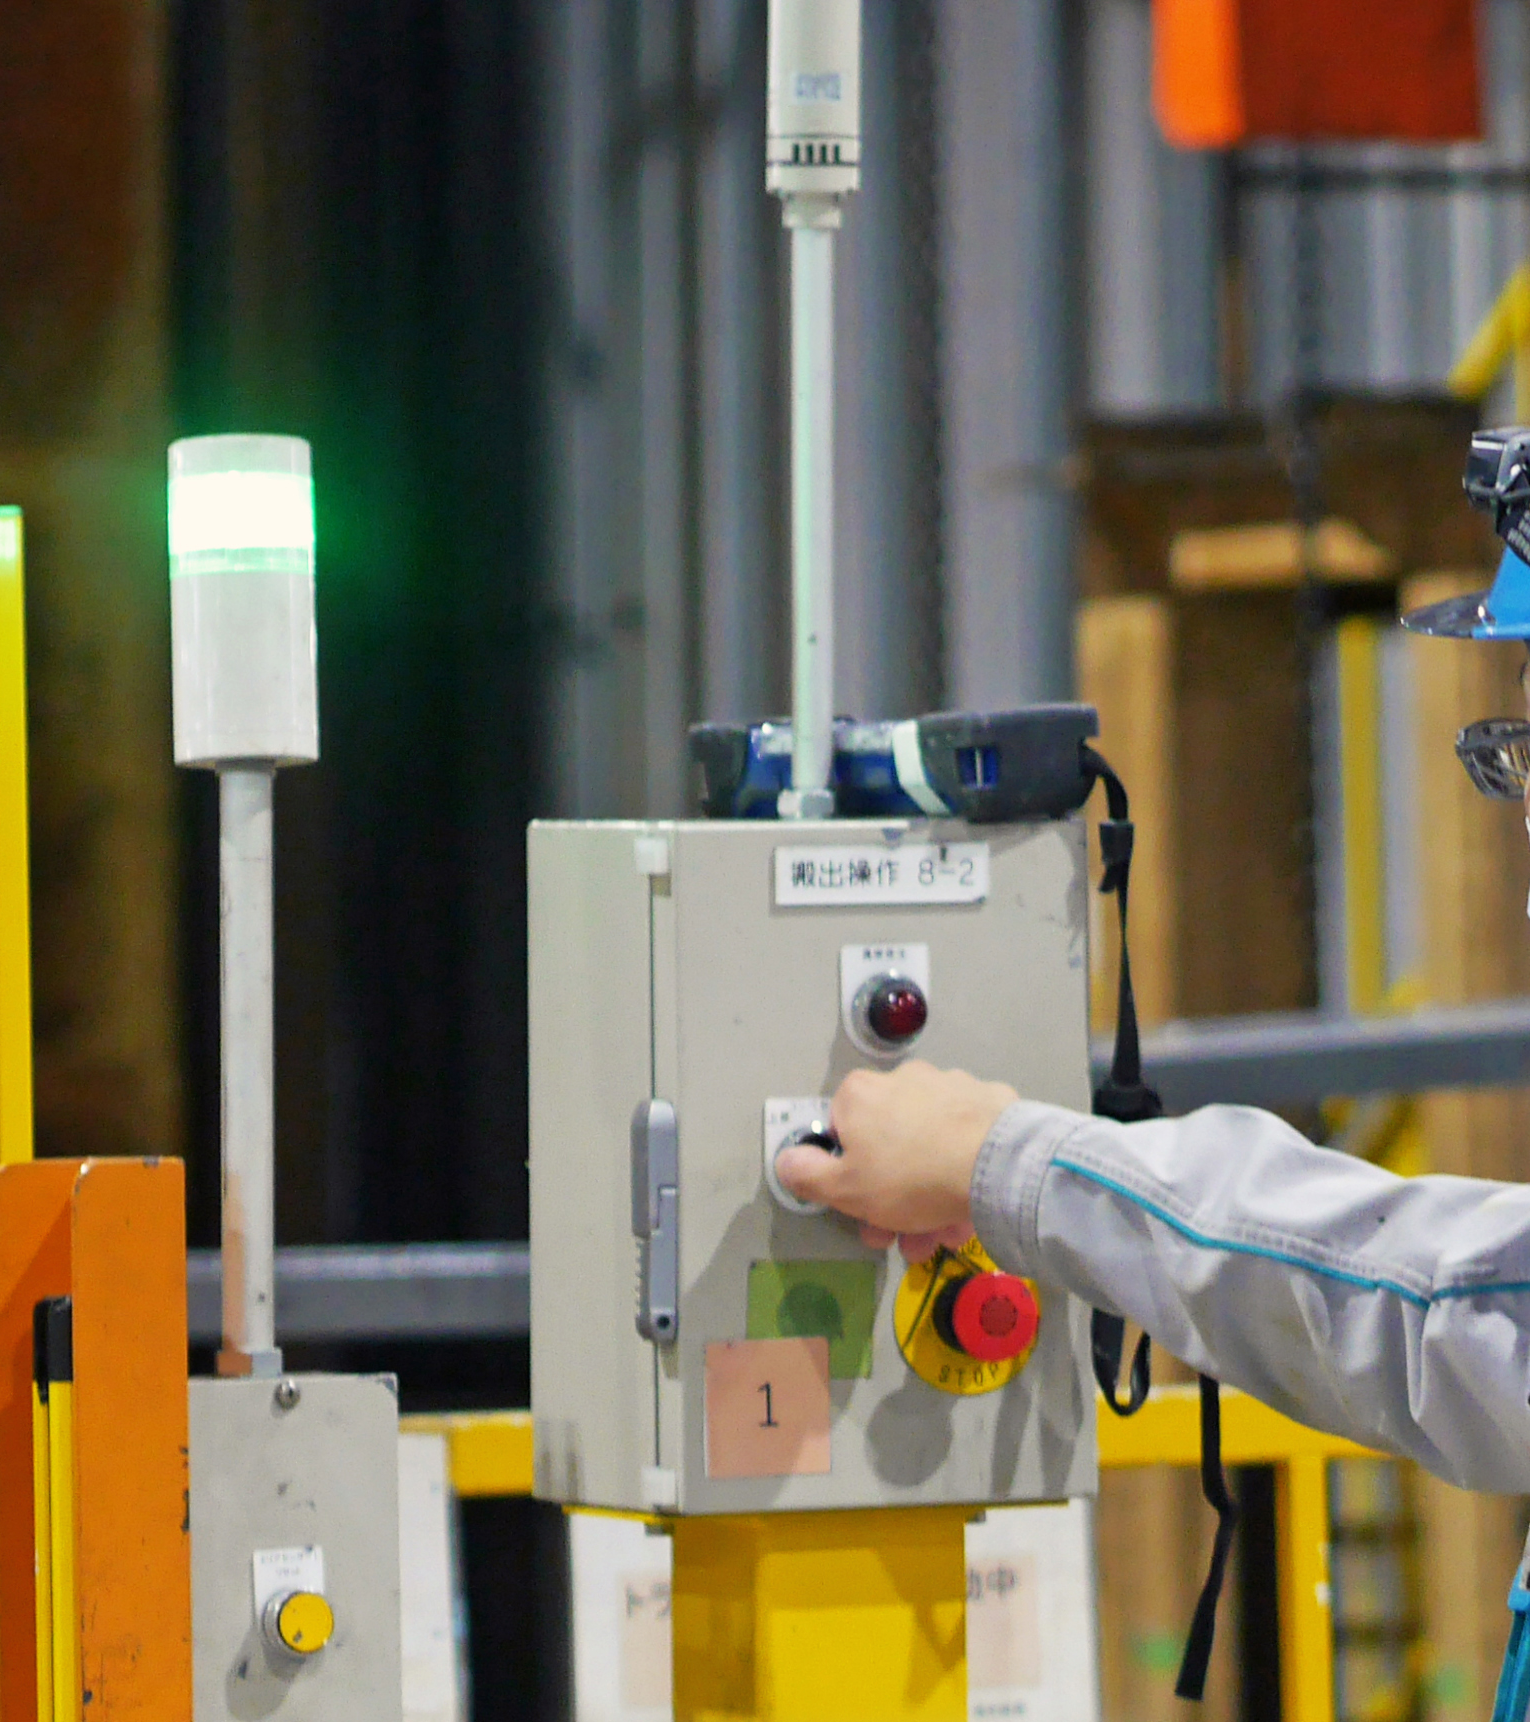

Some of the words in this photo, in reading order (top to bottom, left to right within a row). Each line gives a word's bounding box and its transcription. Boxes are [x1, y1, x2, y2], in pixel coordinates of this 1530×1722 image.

[791, 859, 900, 887] 搬出操作
[918, 858, 974, 886] 8-2
[938, 1363, 999, 1387] STOP
[758, 1382, 778, 1428] 1
